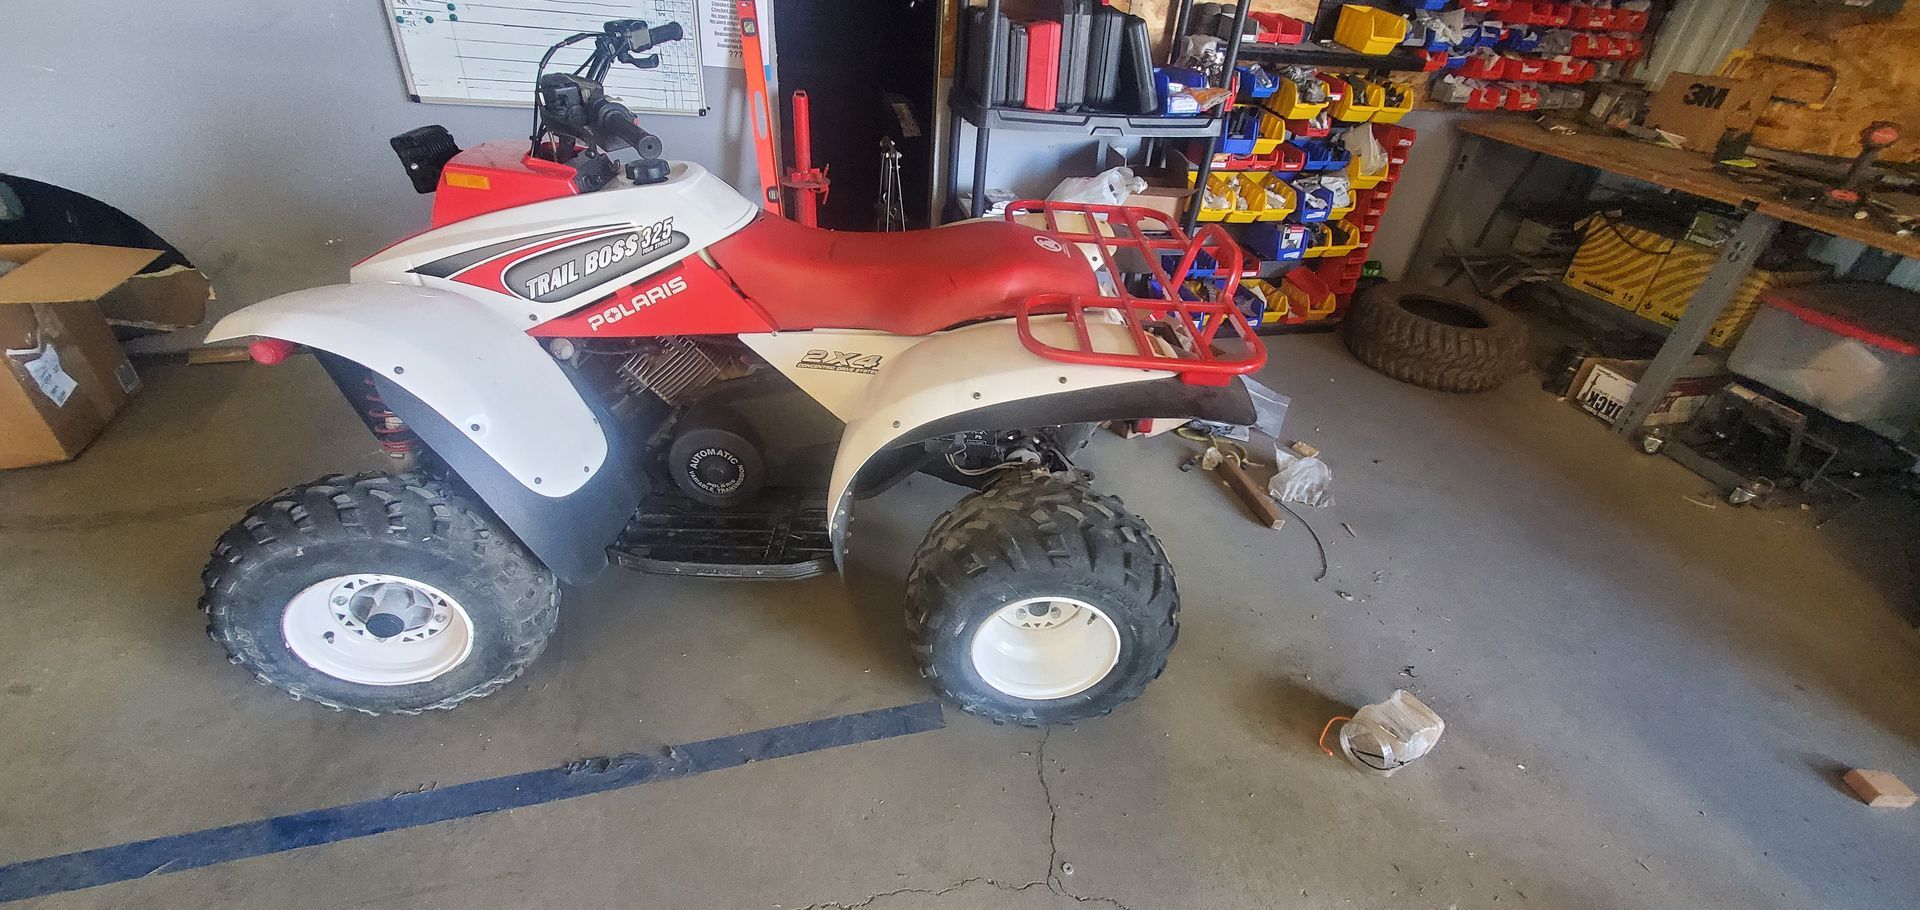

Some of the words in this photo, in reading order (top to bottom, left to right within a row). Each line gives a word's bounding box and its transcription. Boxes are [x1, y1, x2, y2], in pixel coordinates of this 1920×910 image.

[1683, 83, 1731, 109] 3M
[525, 259, 580, 301] TRAIL
[584, 233, 640, 277] BOSS
[640, 216, 674, 249] 325
[587, 275, 688, 332] POLARIS
[800, 349, 883, 369] 2X4
[1587, 390, 1624, 420] JACK
[689, 448, 738, 470] AUTOMATIC
[689, 470, 715, 493] VARIABLE
[716, 464, 745, 494] TRANSMISSION
